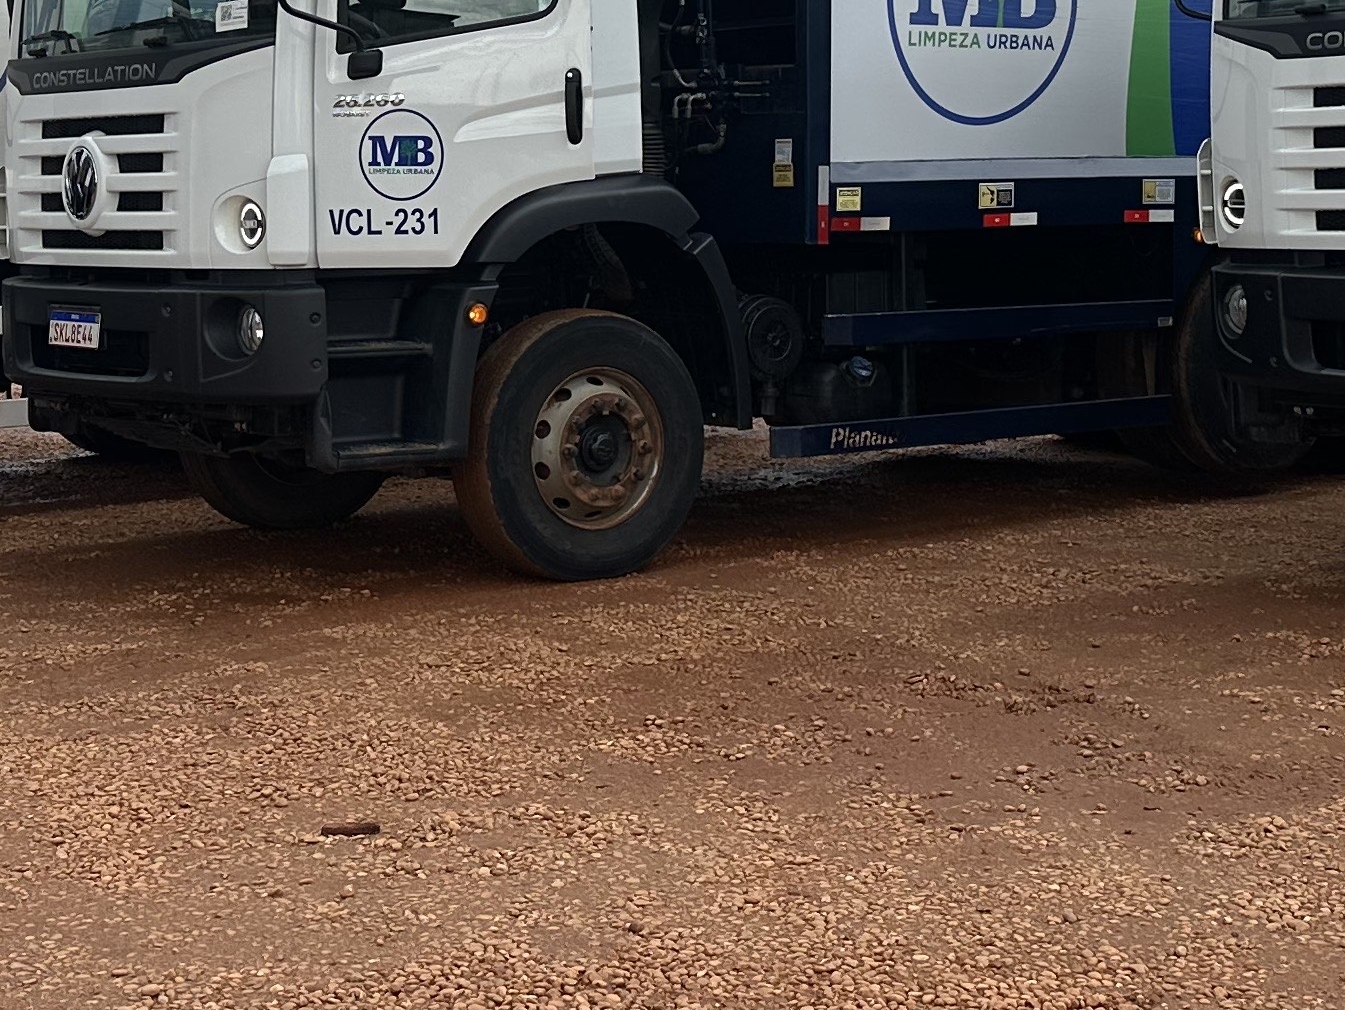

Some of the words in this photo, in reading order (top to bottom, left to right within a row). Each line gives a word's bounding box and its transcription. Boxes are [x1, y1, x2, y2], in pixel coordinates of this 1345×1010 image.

[908, 31, 981, 49] LIMPEZA
[987, 34, 1055, 51] URBANA
[33, 63, 156, 89] CONSTELLATION
[368, 135, 435, 167] MB
[328, 208, 439, 235] VCL-231
